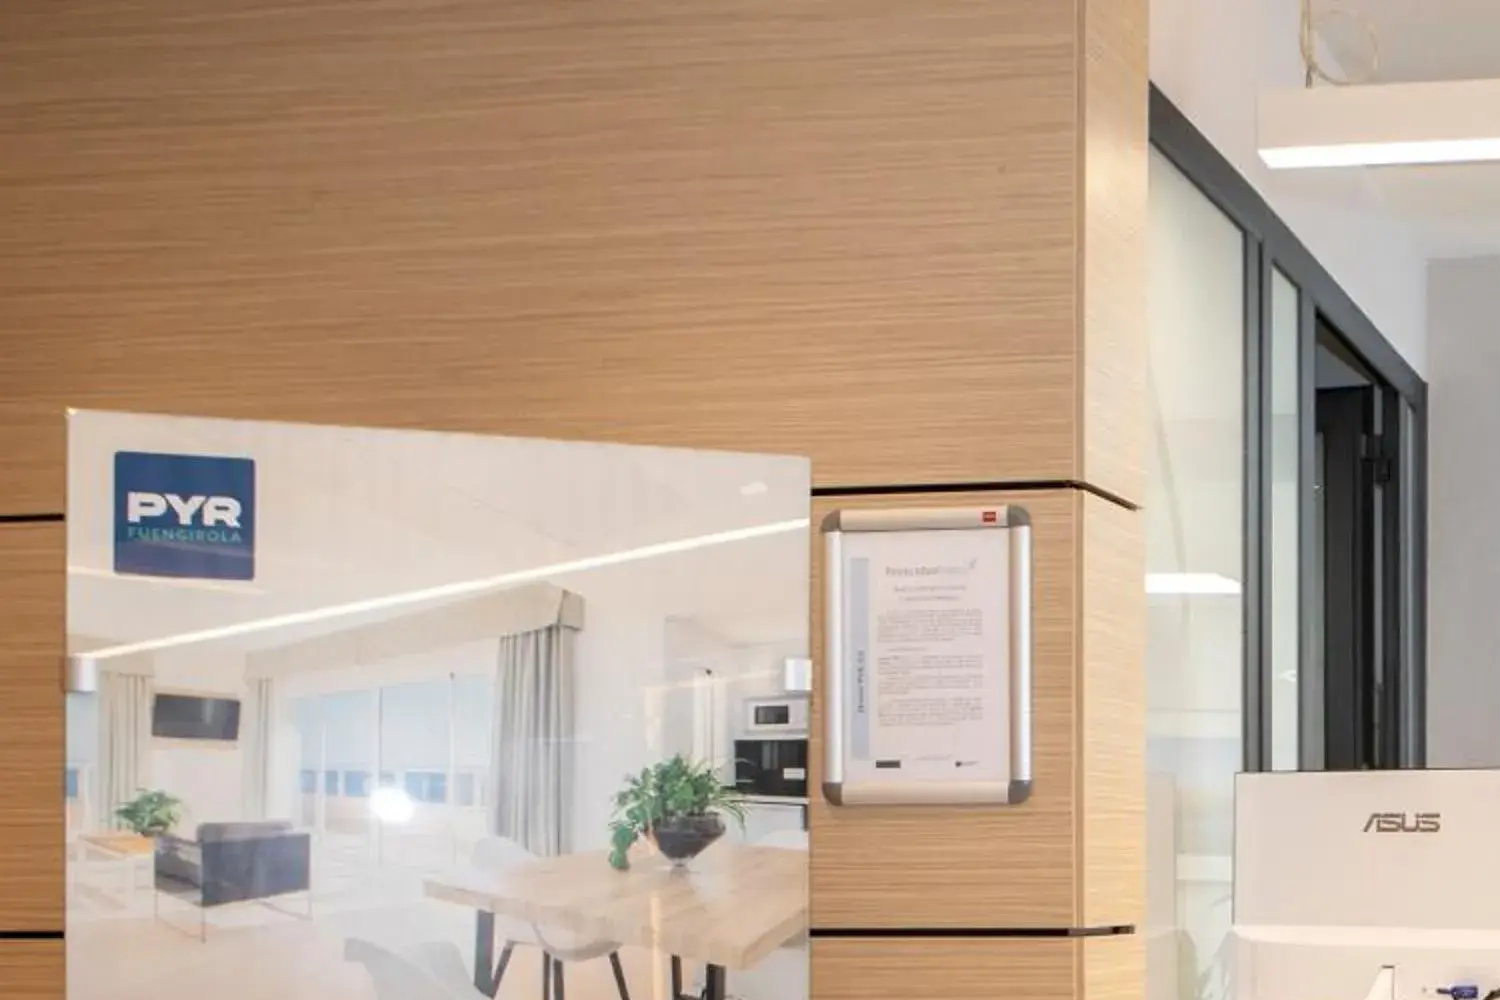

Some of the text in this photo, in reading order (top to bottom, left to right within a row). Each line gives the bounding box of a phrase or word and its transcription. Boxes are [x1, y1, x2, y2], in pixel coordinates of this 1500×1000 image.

[127, 491, 242, 528] PYR
[127, 527, 242, 543] FUENGIROLA
[1363, 812, 1441, 832] ASUS
